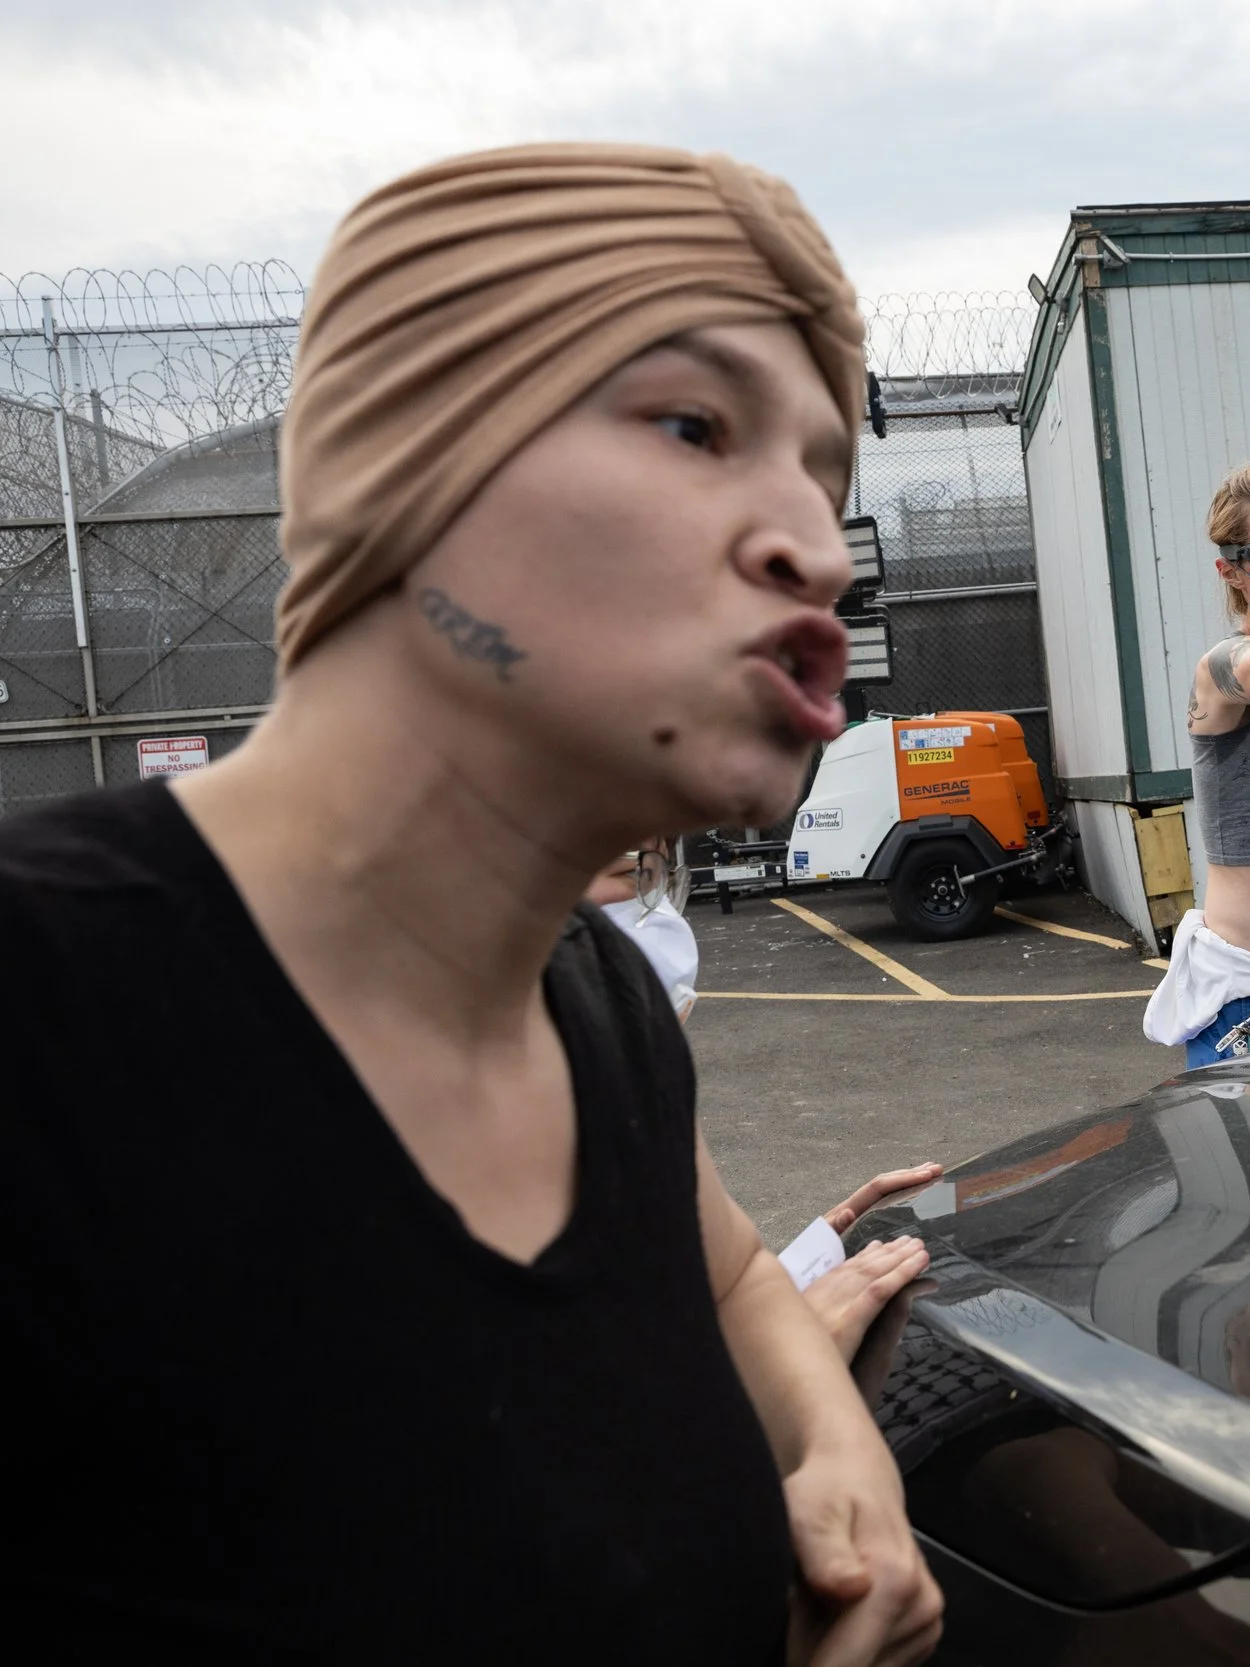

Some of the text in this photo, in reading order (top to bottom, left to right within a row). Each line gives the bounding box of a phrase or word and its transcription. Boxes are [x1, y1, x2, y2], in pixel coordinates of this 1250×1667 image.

[908, 750, 953, 763] 11927234
[145, 763, 205, 773] TRESPASSING
[903, 779, 970, 797] GENERAC
[814, 811, 838, 820] United
[814, 820, 841, 828] Rentals
